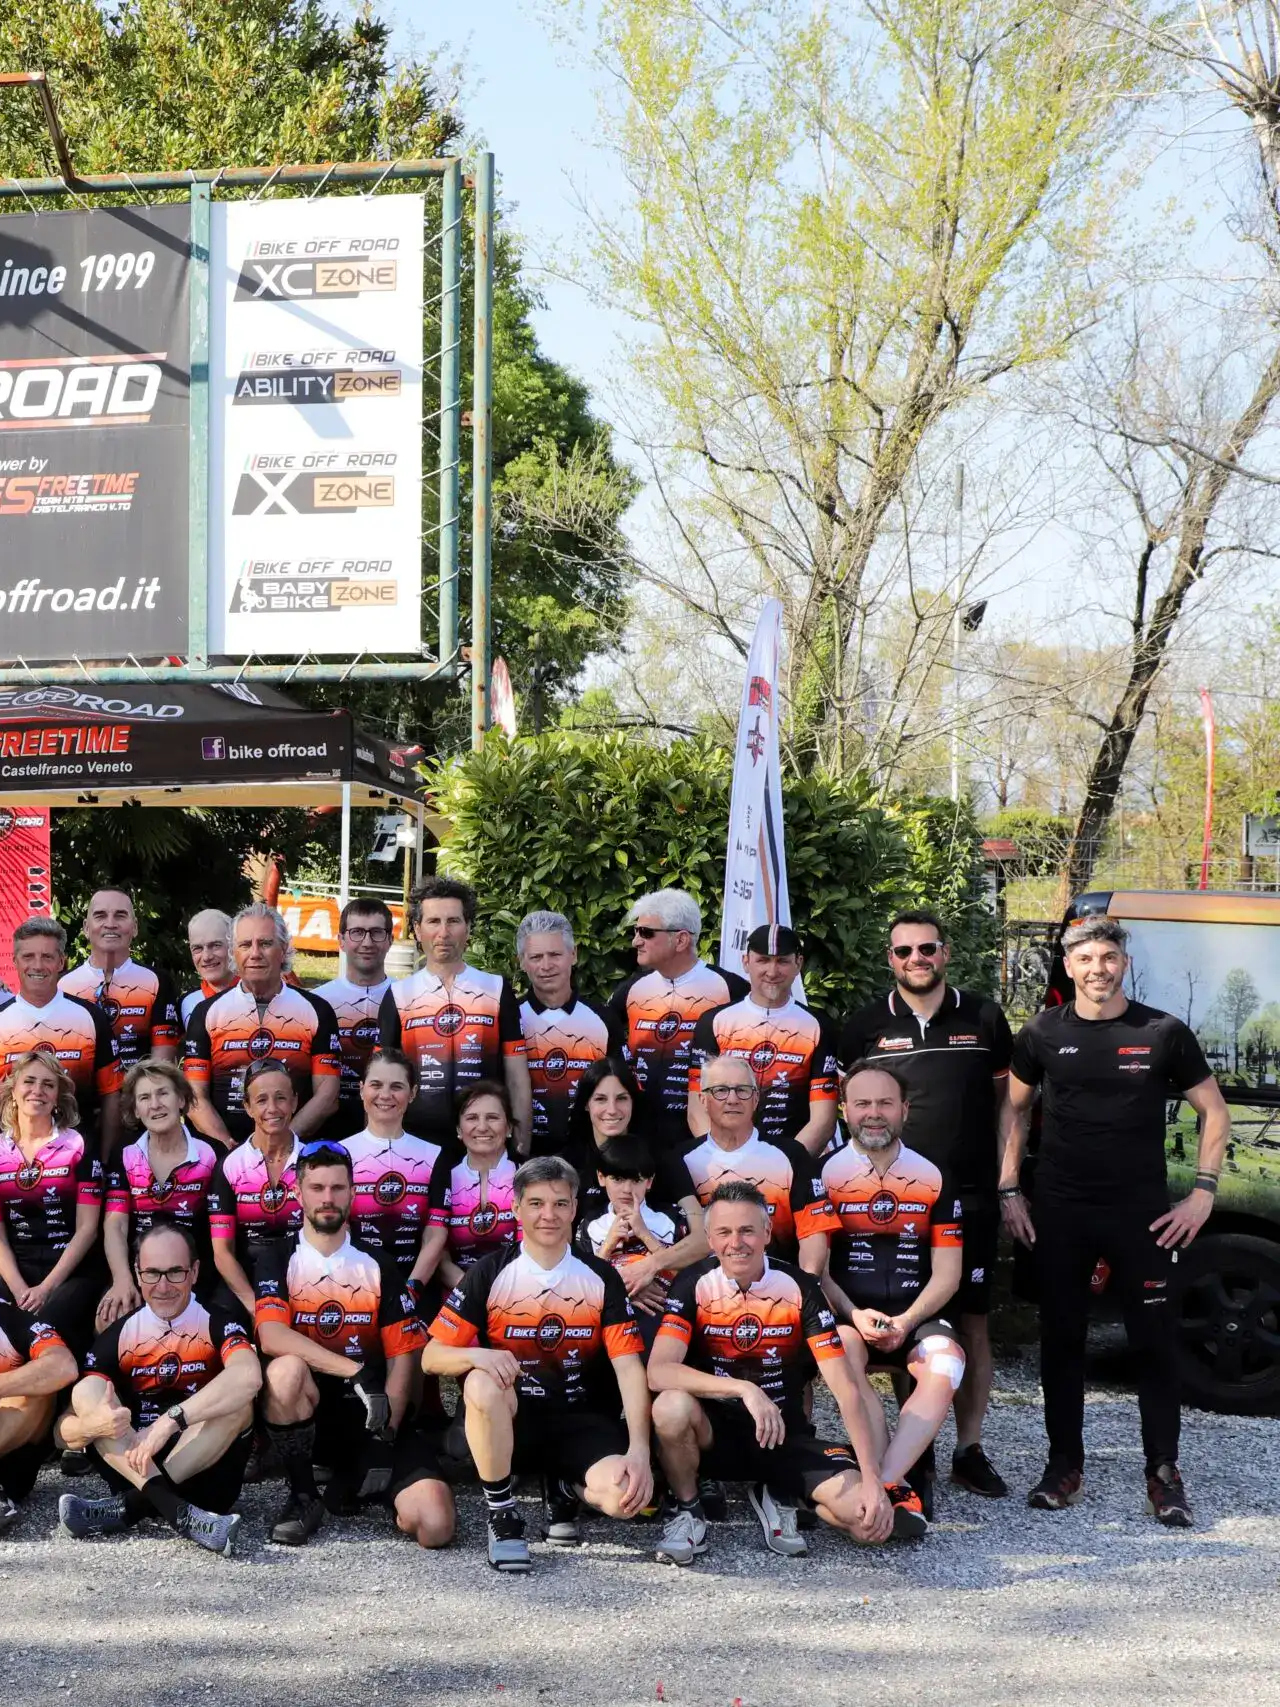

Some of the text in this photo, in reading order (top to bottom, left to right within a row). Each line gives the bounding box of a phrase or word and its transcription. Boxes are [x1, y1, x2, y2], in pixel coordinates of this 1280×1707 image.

[259, 239, 399, 255] BIKE OFF ROAD
[80, 251, 155, 292] 1999
[253, 264, 394, 296] XC ZONE
[256, 351, 396, 366] BIKE OFF ROAD
[238, 376, 398, 397] ABILITY ZONE
[29, 457, 48, 473] by
[257, 454, 397, 468] BIKE OFF ROAD
[38, 473, 139, 496] FREETIME
[320, 483, 391, 501] ZONE
[253, 561, 392, 574] BIKE OFF ROAD
[263, 582, 394, 601] BABY ZONE
[271, 596, 328, 608] BIKE
[22, 691, 69, 702] OFF
[74, 694, 185, 718] ROAD
[229, 743, 327, 759] bike offroad
[2, 764, 83, 776] Castelfranco
[88, 761, 132, 773] Veneto
[15, 818, 44, 826] ROAD
[438, 1016, 460, 1024] OFF
[465, 1015, 494, 1025] ROAD
[274, 1041, 299, 1049] ROAD
[547, 1060, 564, 1068] OFF
[776, 1054, 802, 1063] ROAD
[43, 1168, 69, 1176] ROAD
[379, 1184, 402, 1192] OFF
[846, 1203, 926, 1212] BIKE OFF ROAD
[320, 1314, 371, 1323] OFF ROAD
[513, 1328, 592, 1337] BIKE OFF ROAD
[737, 1327, 758, 1335] OFF
[762, 1327, 792, 1335] ROAD
[159, 1366, 178, 1375] OFF
